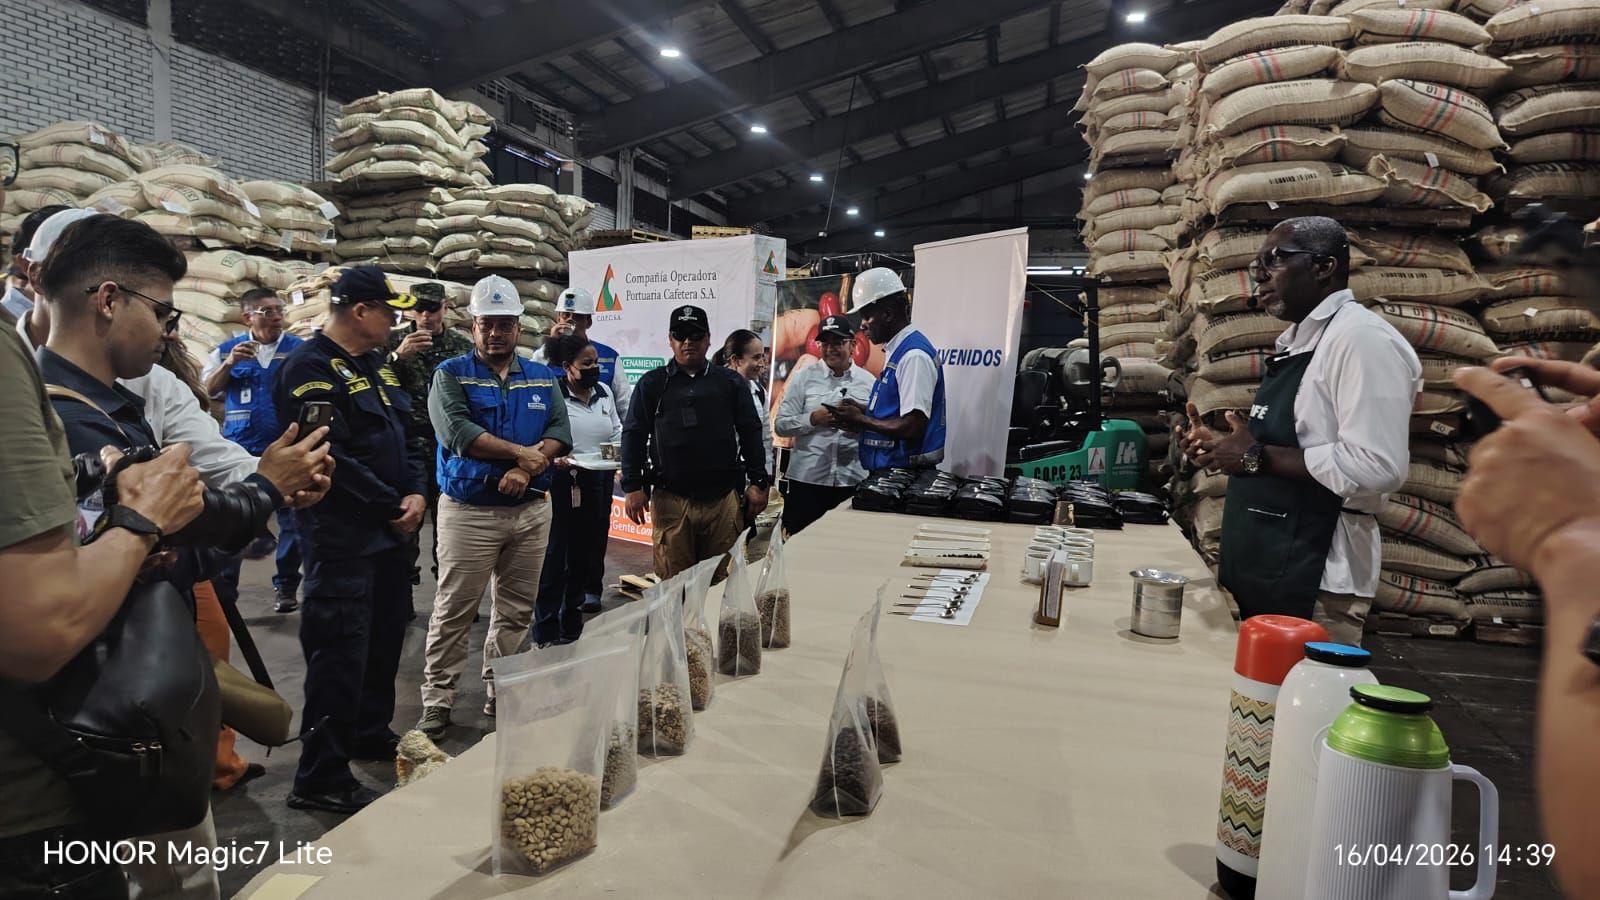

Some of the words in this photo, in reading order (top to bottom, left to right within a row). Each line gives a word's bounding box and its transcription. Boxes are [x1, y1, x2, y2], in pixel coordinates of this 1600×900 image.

[625, 271, 668, 287] Compañía
[670, 269, 717, 286] Operadora
[626, 289, 662, 301] Portuaria
[663, 288, 698, 300] Cafetera
[700, 287, 717, 300] S.A.
[1069, 464, 1082, 480] 23
[613, 520, 636, 533] Gente
